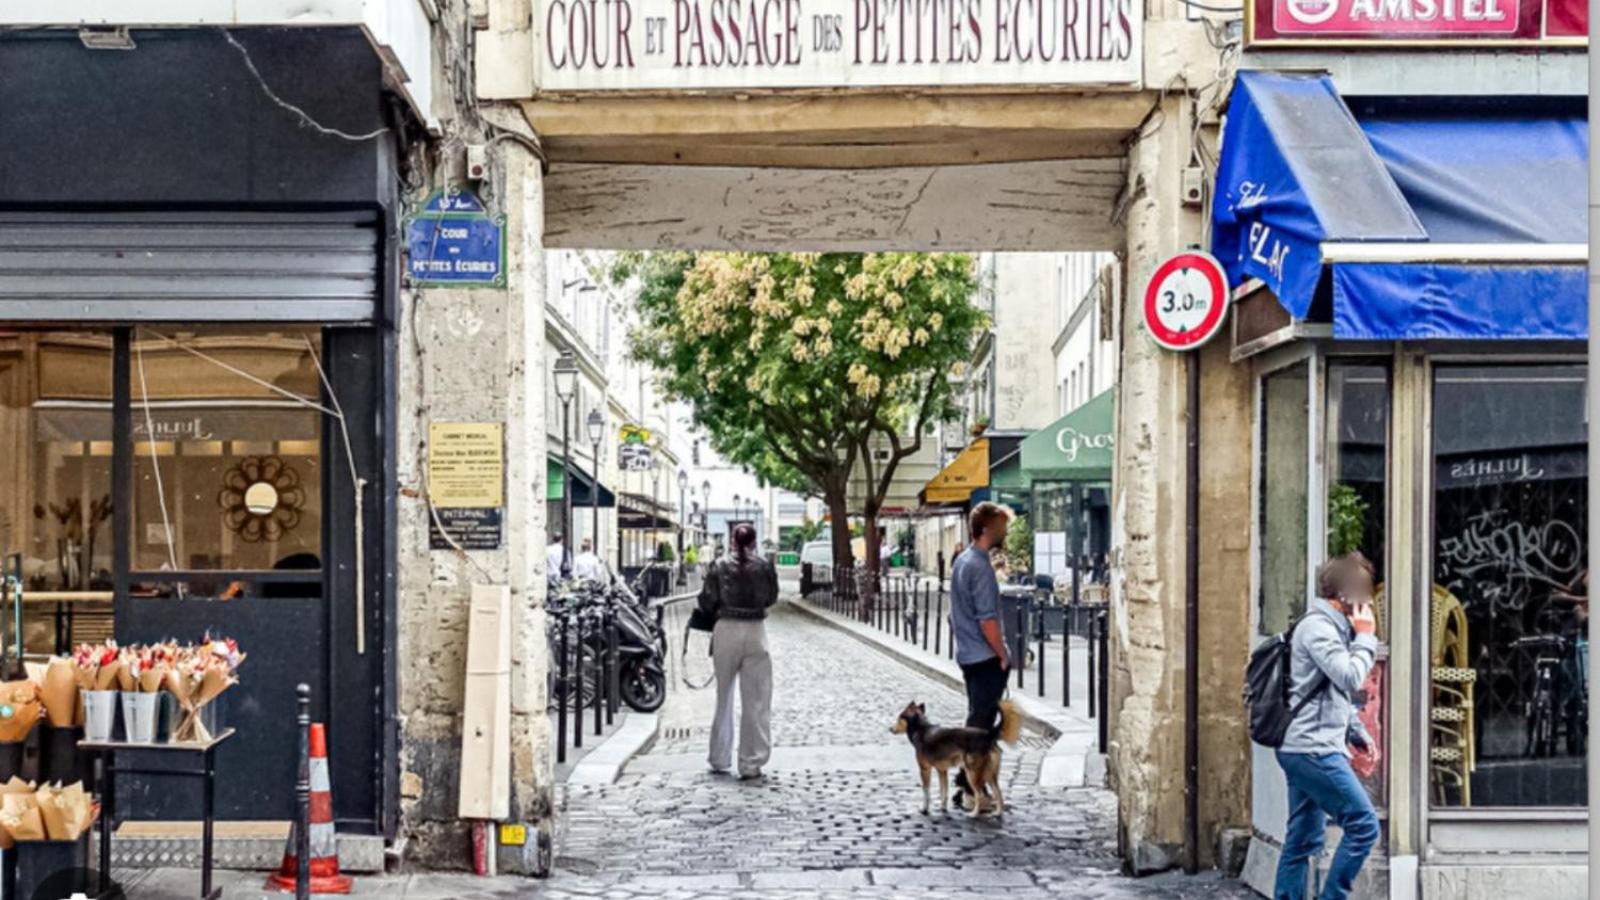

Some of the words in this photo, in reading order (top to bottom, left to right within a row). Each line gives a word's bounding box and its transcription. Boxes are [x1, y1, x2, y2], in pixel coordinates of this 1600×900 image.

[1349, 0, 1506, 21] AMSTEL
[546, 0, 635, 70] COUR
[645, 17, 668, 54] ET
[673, 0, 801, 67] PASSAGE
[812, 14, 843, 51] DES
[852, 0, 983, 64] PETITES
[993, 0, 1133, 62] ECURIES
[441, 228, 469, 239] COUR
